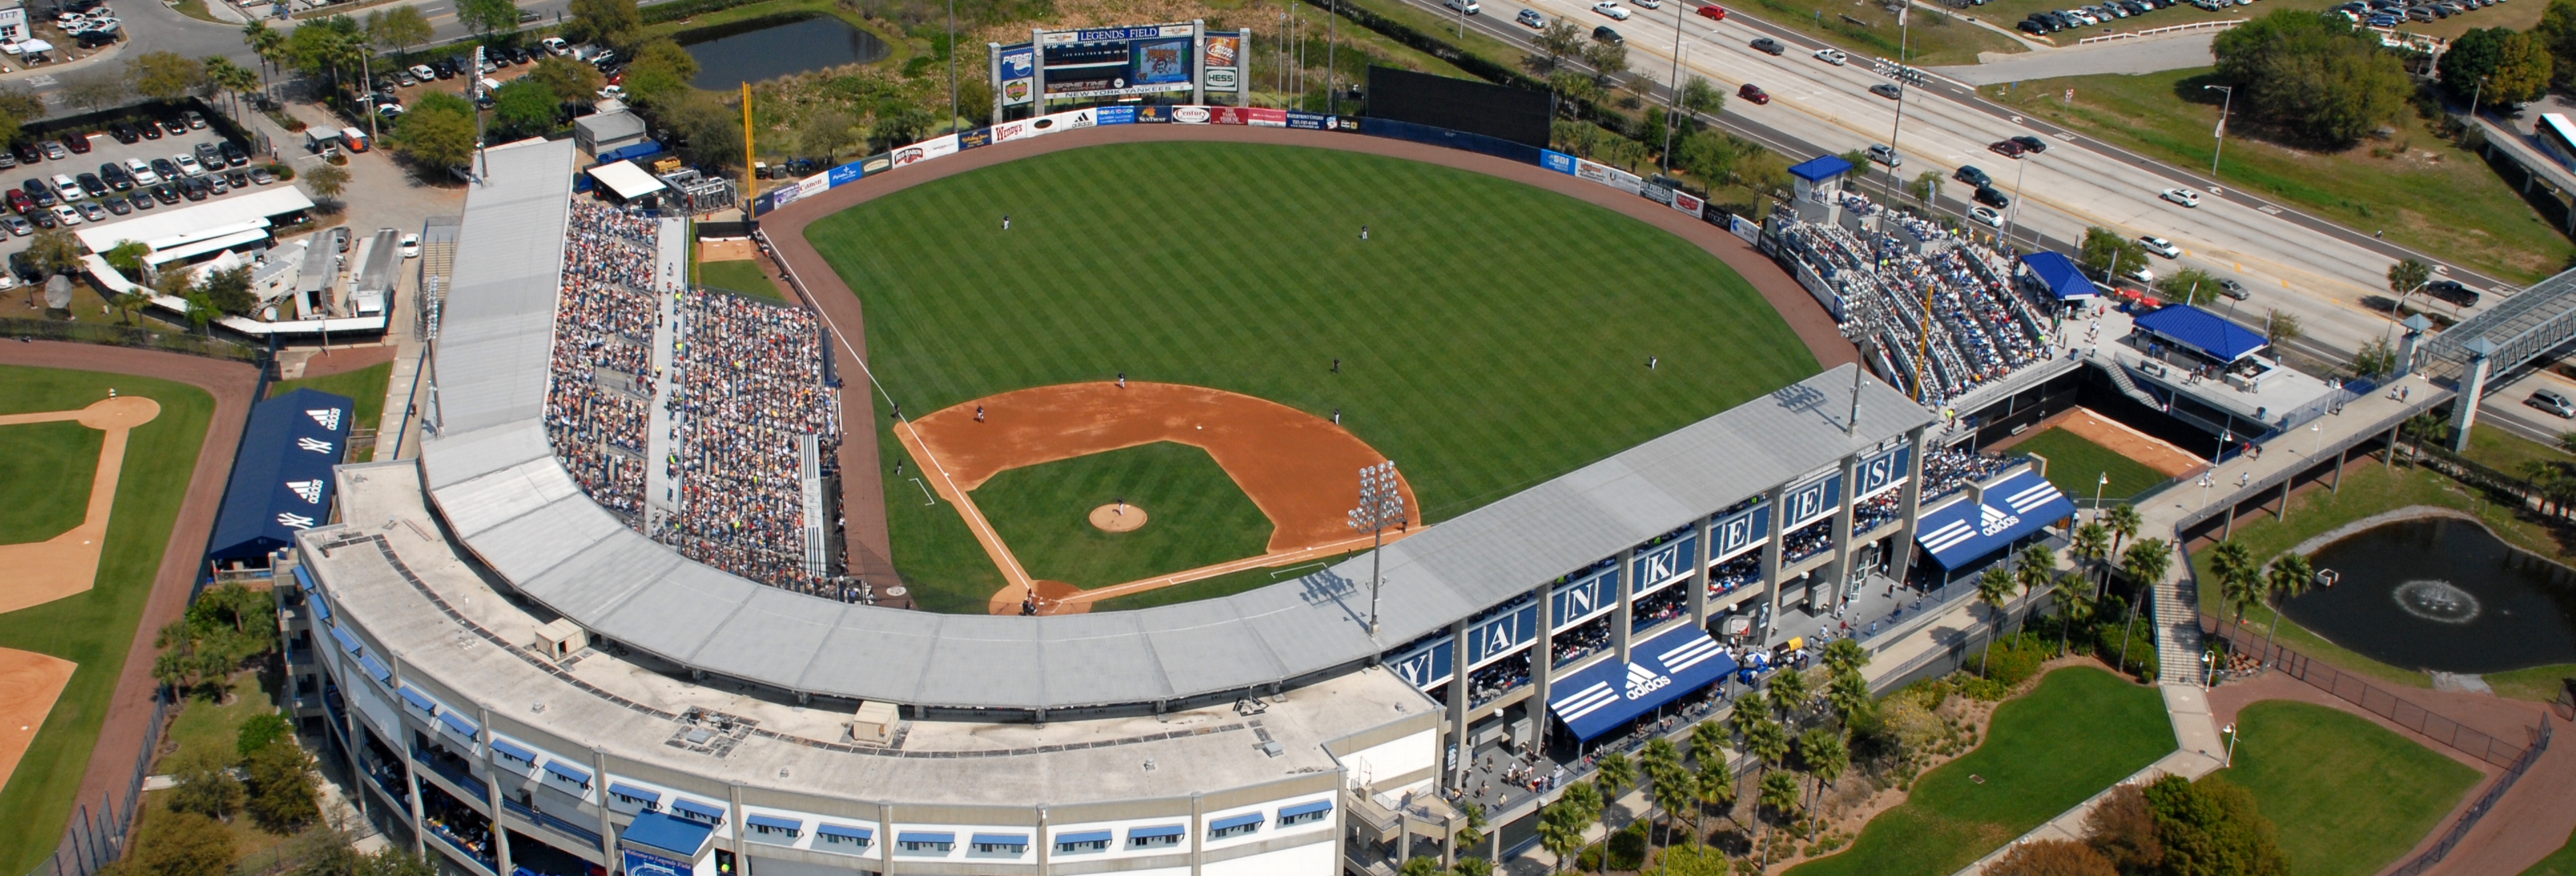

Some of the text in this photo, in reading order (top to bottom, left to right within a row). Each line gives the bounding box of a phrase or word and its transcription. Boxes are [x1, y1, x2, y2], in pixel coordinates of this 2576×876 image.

[1080, 28, 1157, 41] LEGENDS FIELD
[1003, 53, 1033, 65] PEPSI
[1176, 109, 1207, 118] Century
[995, 124, 1023, 141] Wendy's
[1553, 154, 1569, 165] SDI
[800, 179, 822, 191] Canon
[327, 408, 341, 431] adidas
[308, 479, 323, 504] adidas
[1982, 515, 2020, 537] adidas
[1626, 675, 1671, 700] adidas
[625, 848, 648, 859] Welcome
